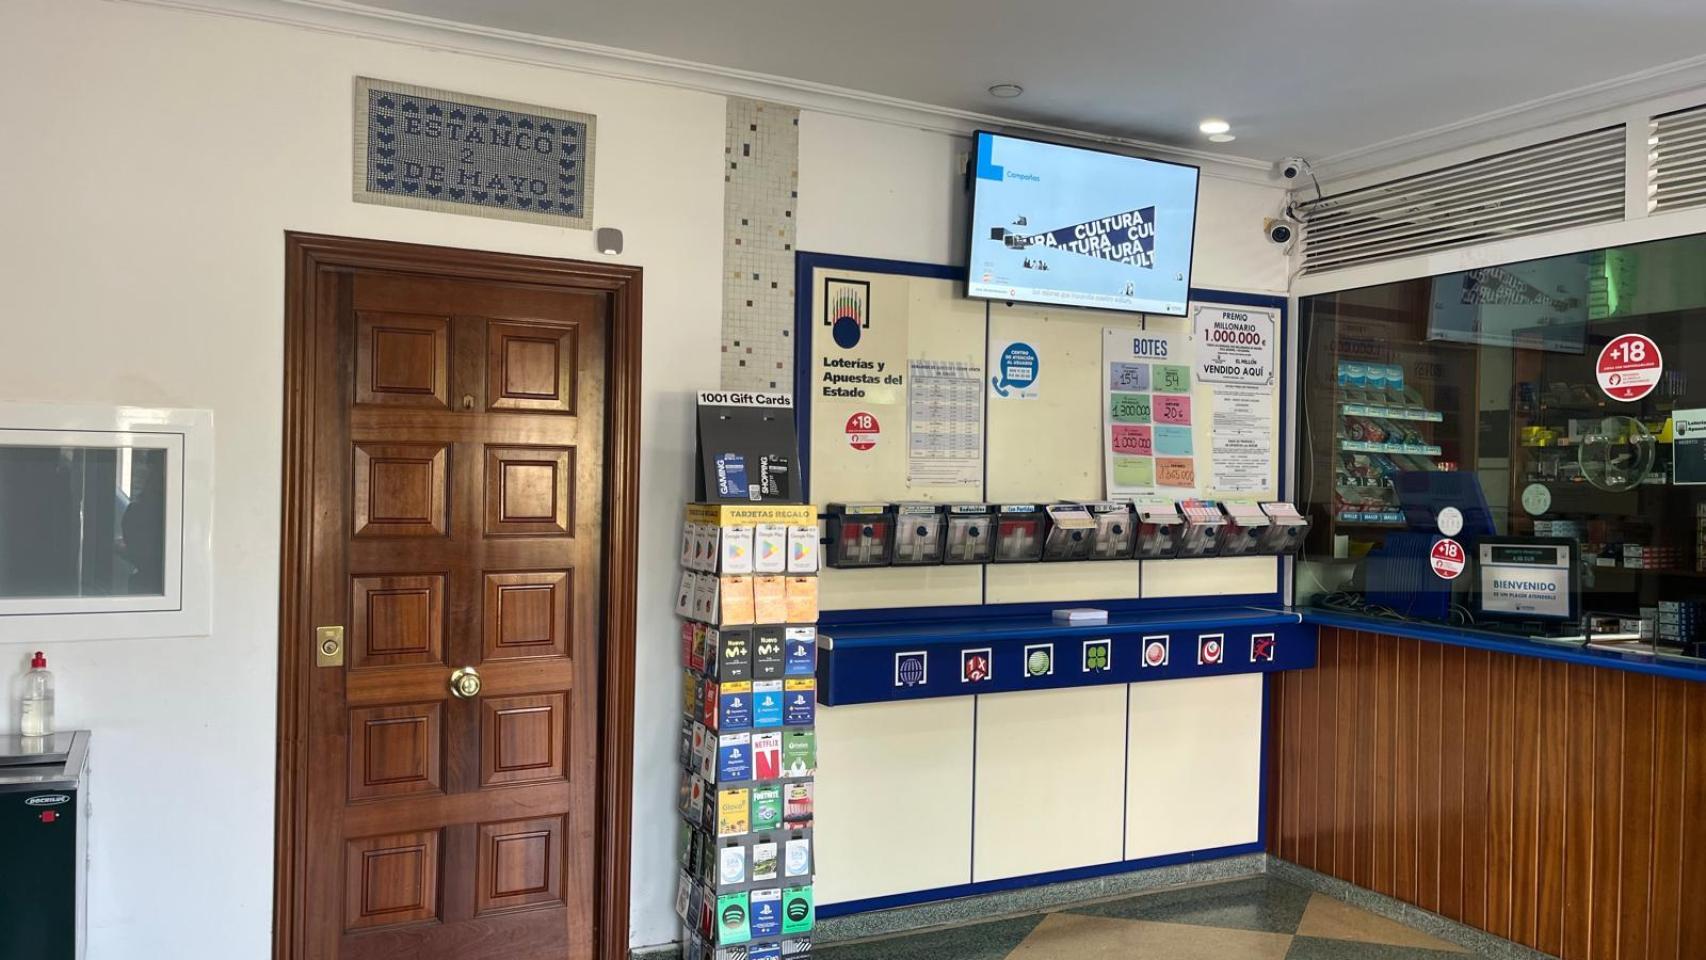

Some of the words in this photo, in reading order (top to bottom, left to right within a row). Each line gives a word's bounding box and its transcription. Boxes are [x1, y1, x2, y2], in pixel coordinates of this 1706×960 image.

[404, 117, 552, 154] ESTANCO
[462, 148, 474, 164] 2
[404, 162, 445, 182] DE
[457, 169, 548, 196] MAYO
[1075, 211, 1143, 240] CULTURA
[1222, 312, 1248, 321] PREMIO
[1214, 322, 1256, 332] MILLONARIO
[1205, 329, 1260, 345] 1.000.000
[1133, 338, 1168, 356] BOTES
[1610, 341, 1645, 363] +18
[823, 357, 874, 369] Loterías
[878, 361, 885, 372] y
[1204, 365, 1240, 375] VENDIDO
[1243, 366, 1264, 376] AQUÍ
[823, 372, 881, 384] Apuestas
[884, 374, 902, 385] del
[1165, 375, 1179, 387] 54
[701, 392, 727, 403] 1001
[730, 392, 753, 404] Gift
[756, 394, 791, 405] Cards
[823, 386, 865, 398] Estado
[852, 416, 872, 429] +18
[717, 460, 728, 494] GAMING
[761, 456, 769, 494] SHOPPING
[731, 510, 774, 518] TARJETAS
[775, 510, 810, 518] REGALO
[1439, 543, 1457, 557] +18
[1494, 580, 1556, 591] BIENVENIDO
[754, 739, 779, 749] NETFLIX
